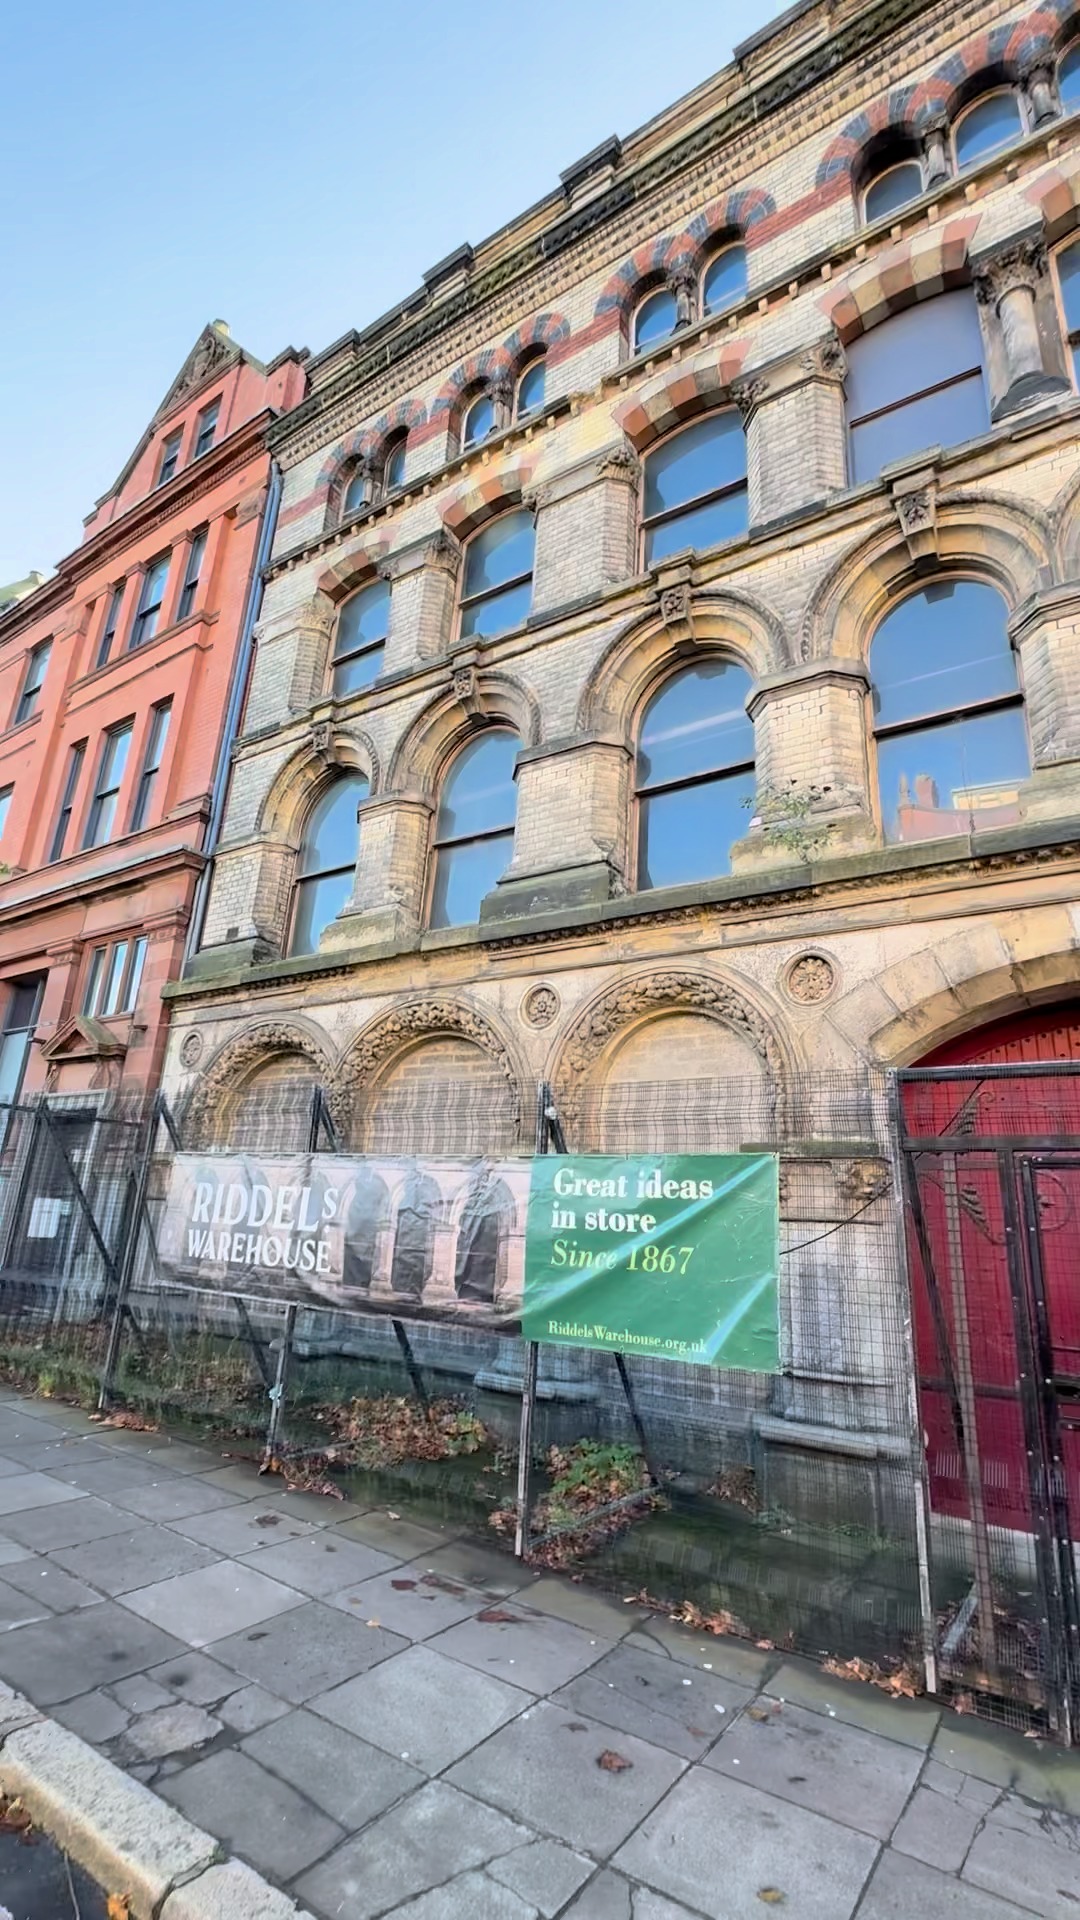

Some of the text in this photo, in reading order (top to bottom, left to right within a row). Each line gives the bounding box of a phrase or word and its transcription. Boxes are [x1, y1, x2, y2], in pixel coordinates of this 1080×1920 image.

[553, 1168, 714, 1200] Great ideas
[551, 1201, 657, 1233] in store
[187, 1230, 332, 1273] WAREHOUSE
[550, 1239, 695, 1275] Since 1867
[548, 1320, 707, 1353] RiddelsWarehouse.org.uk
